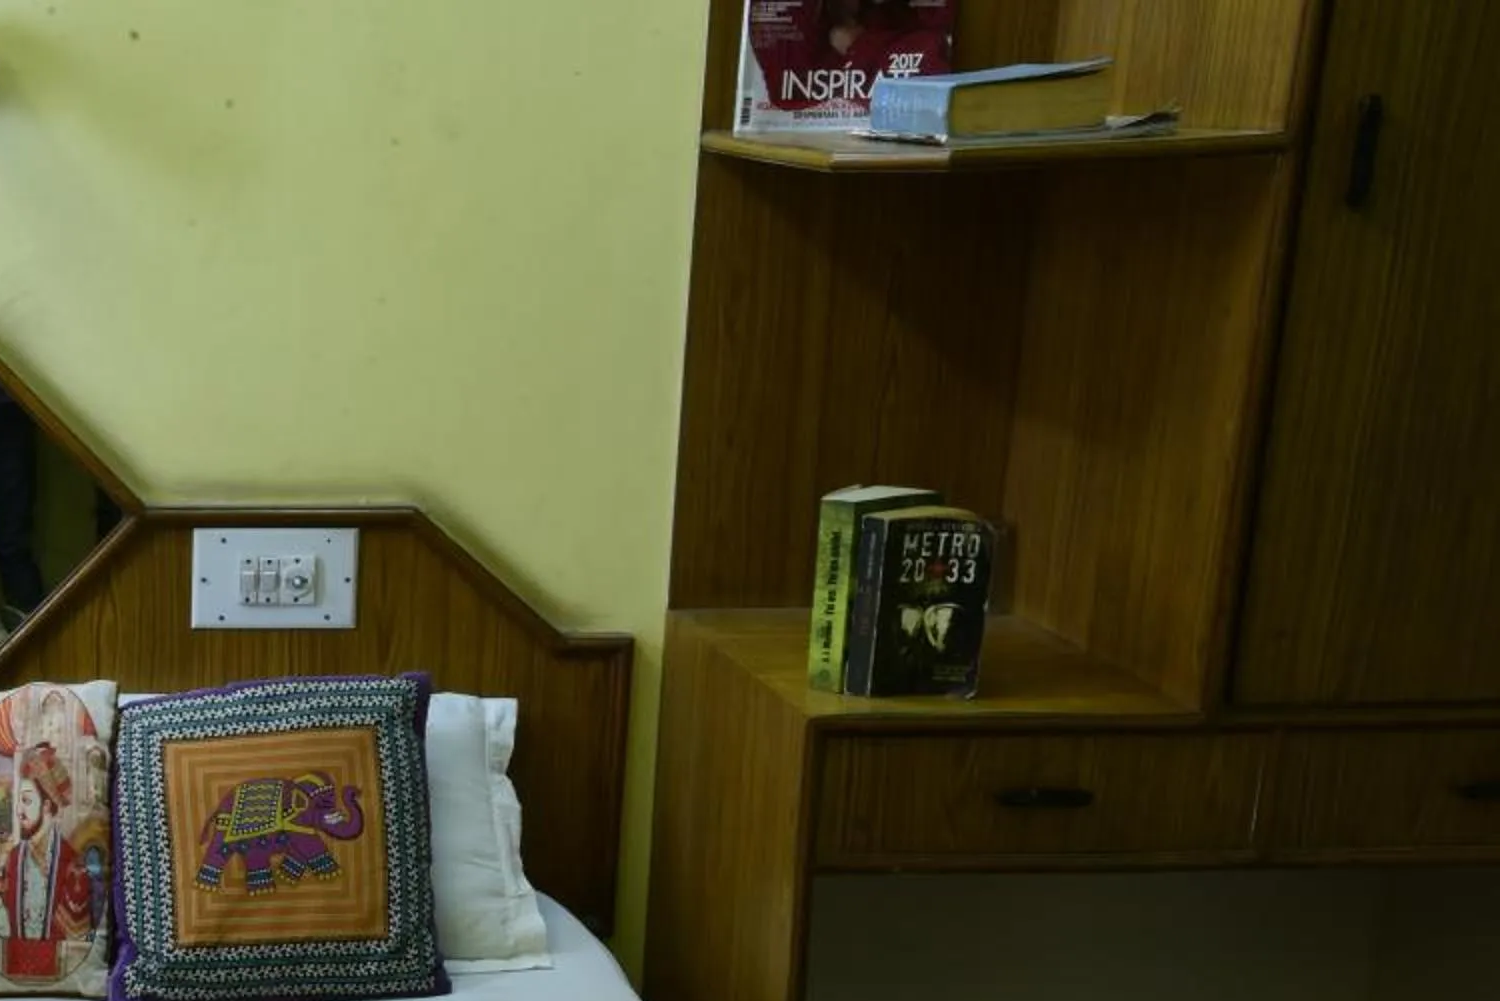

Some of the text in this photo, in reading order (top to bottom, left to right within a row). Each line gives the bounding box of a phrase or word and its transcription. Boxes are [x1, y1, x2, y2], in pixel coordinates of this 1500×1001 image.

[888, 52, 925, 69] 2017
[780, 60, 920, 100] INSPÍRA
[902, 531, 982, 559] METRO
